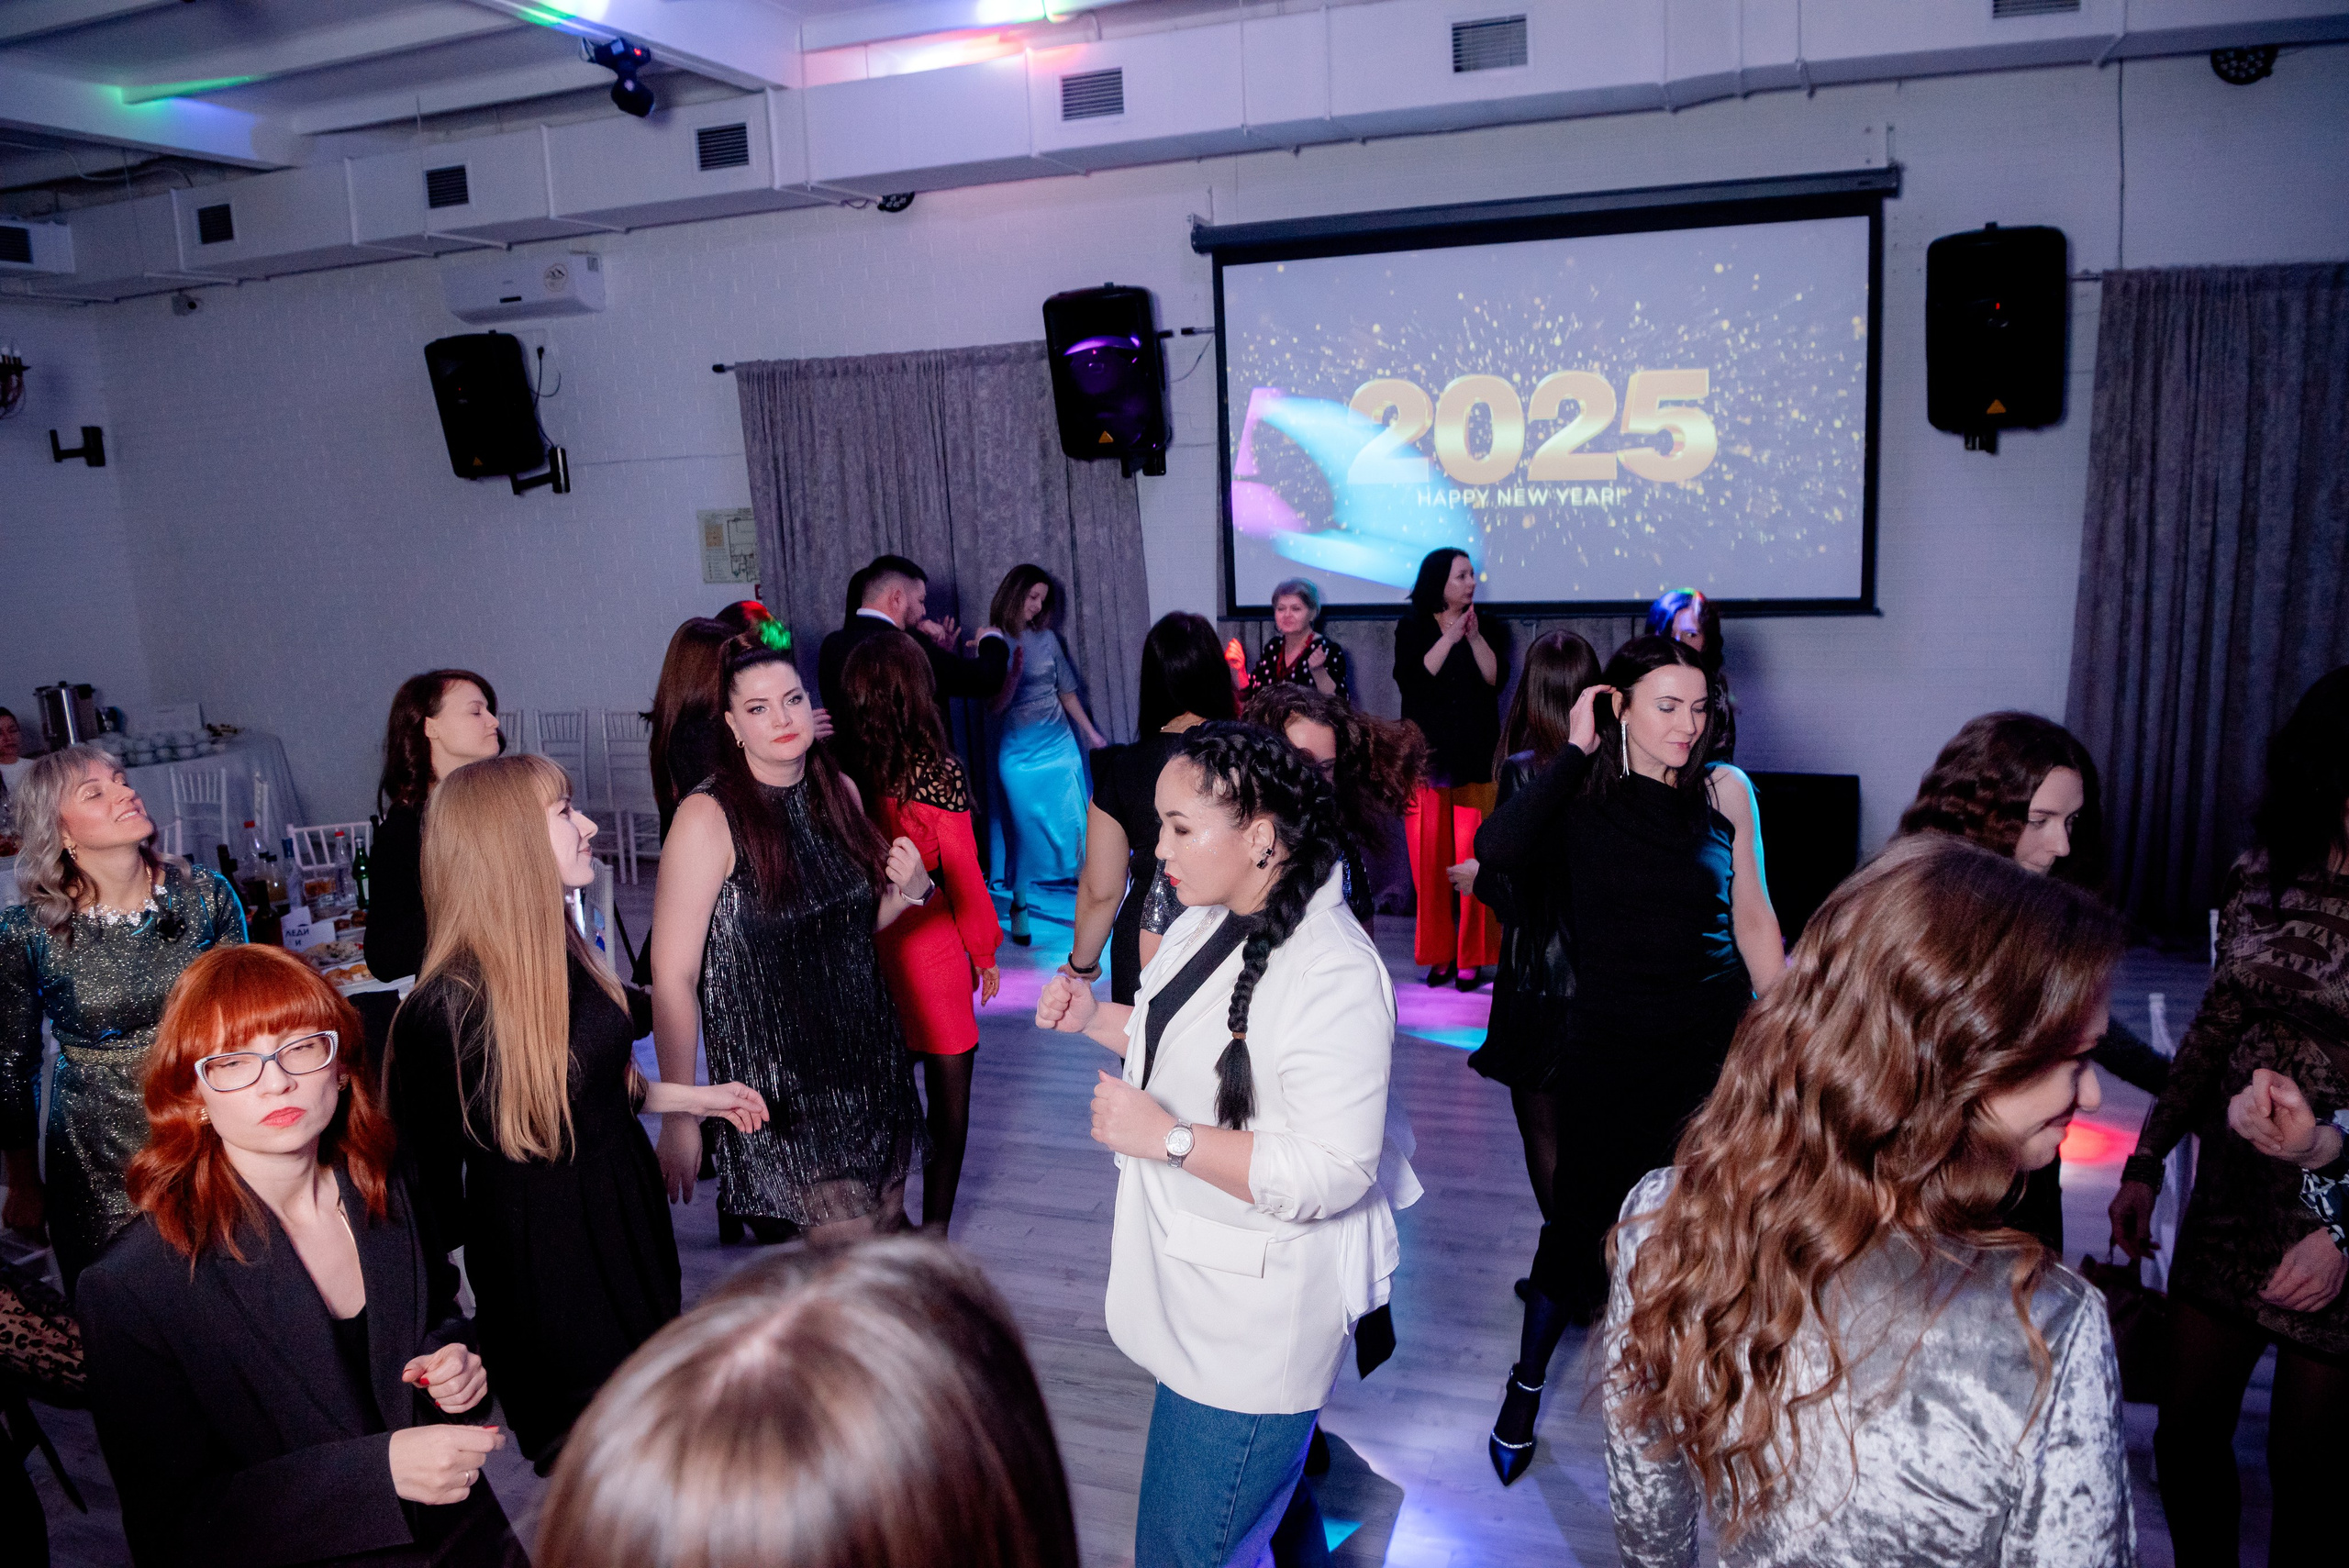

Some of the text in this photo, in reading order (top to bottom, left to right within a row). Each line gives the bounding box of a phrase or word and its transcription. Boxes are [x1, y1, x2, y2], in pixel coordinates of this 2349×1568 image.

[1346, 368, 1718, 484] 2025
[1417, 486, 1621, 508] HAPPY NEW YEAR!
[284, 929, 309, 937] ЛЕДИ
